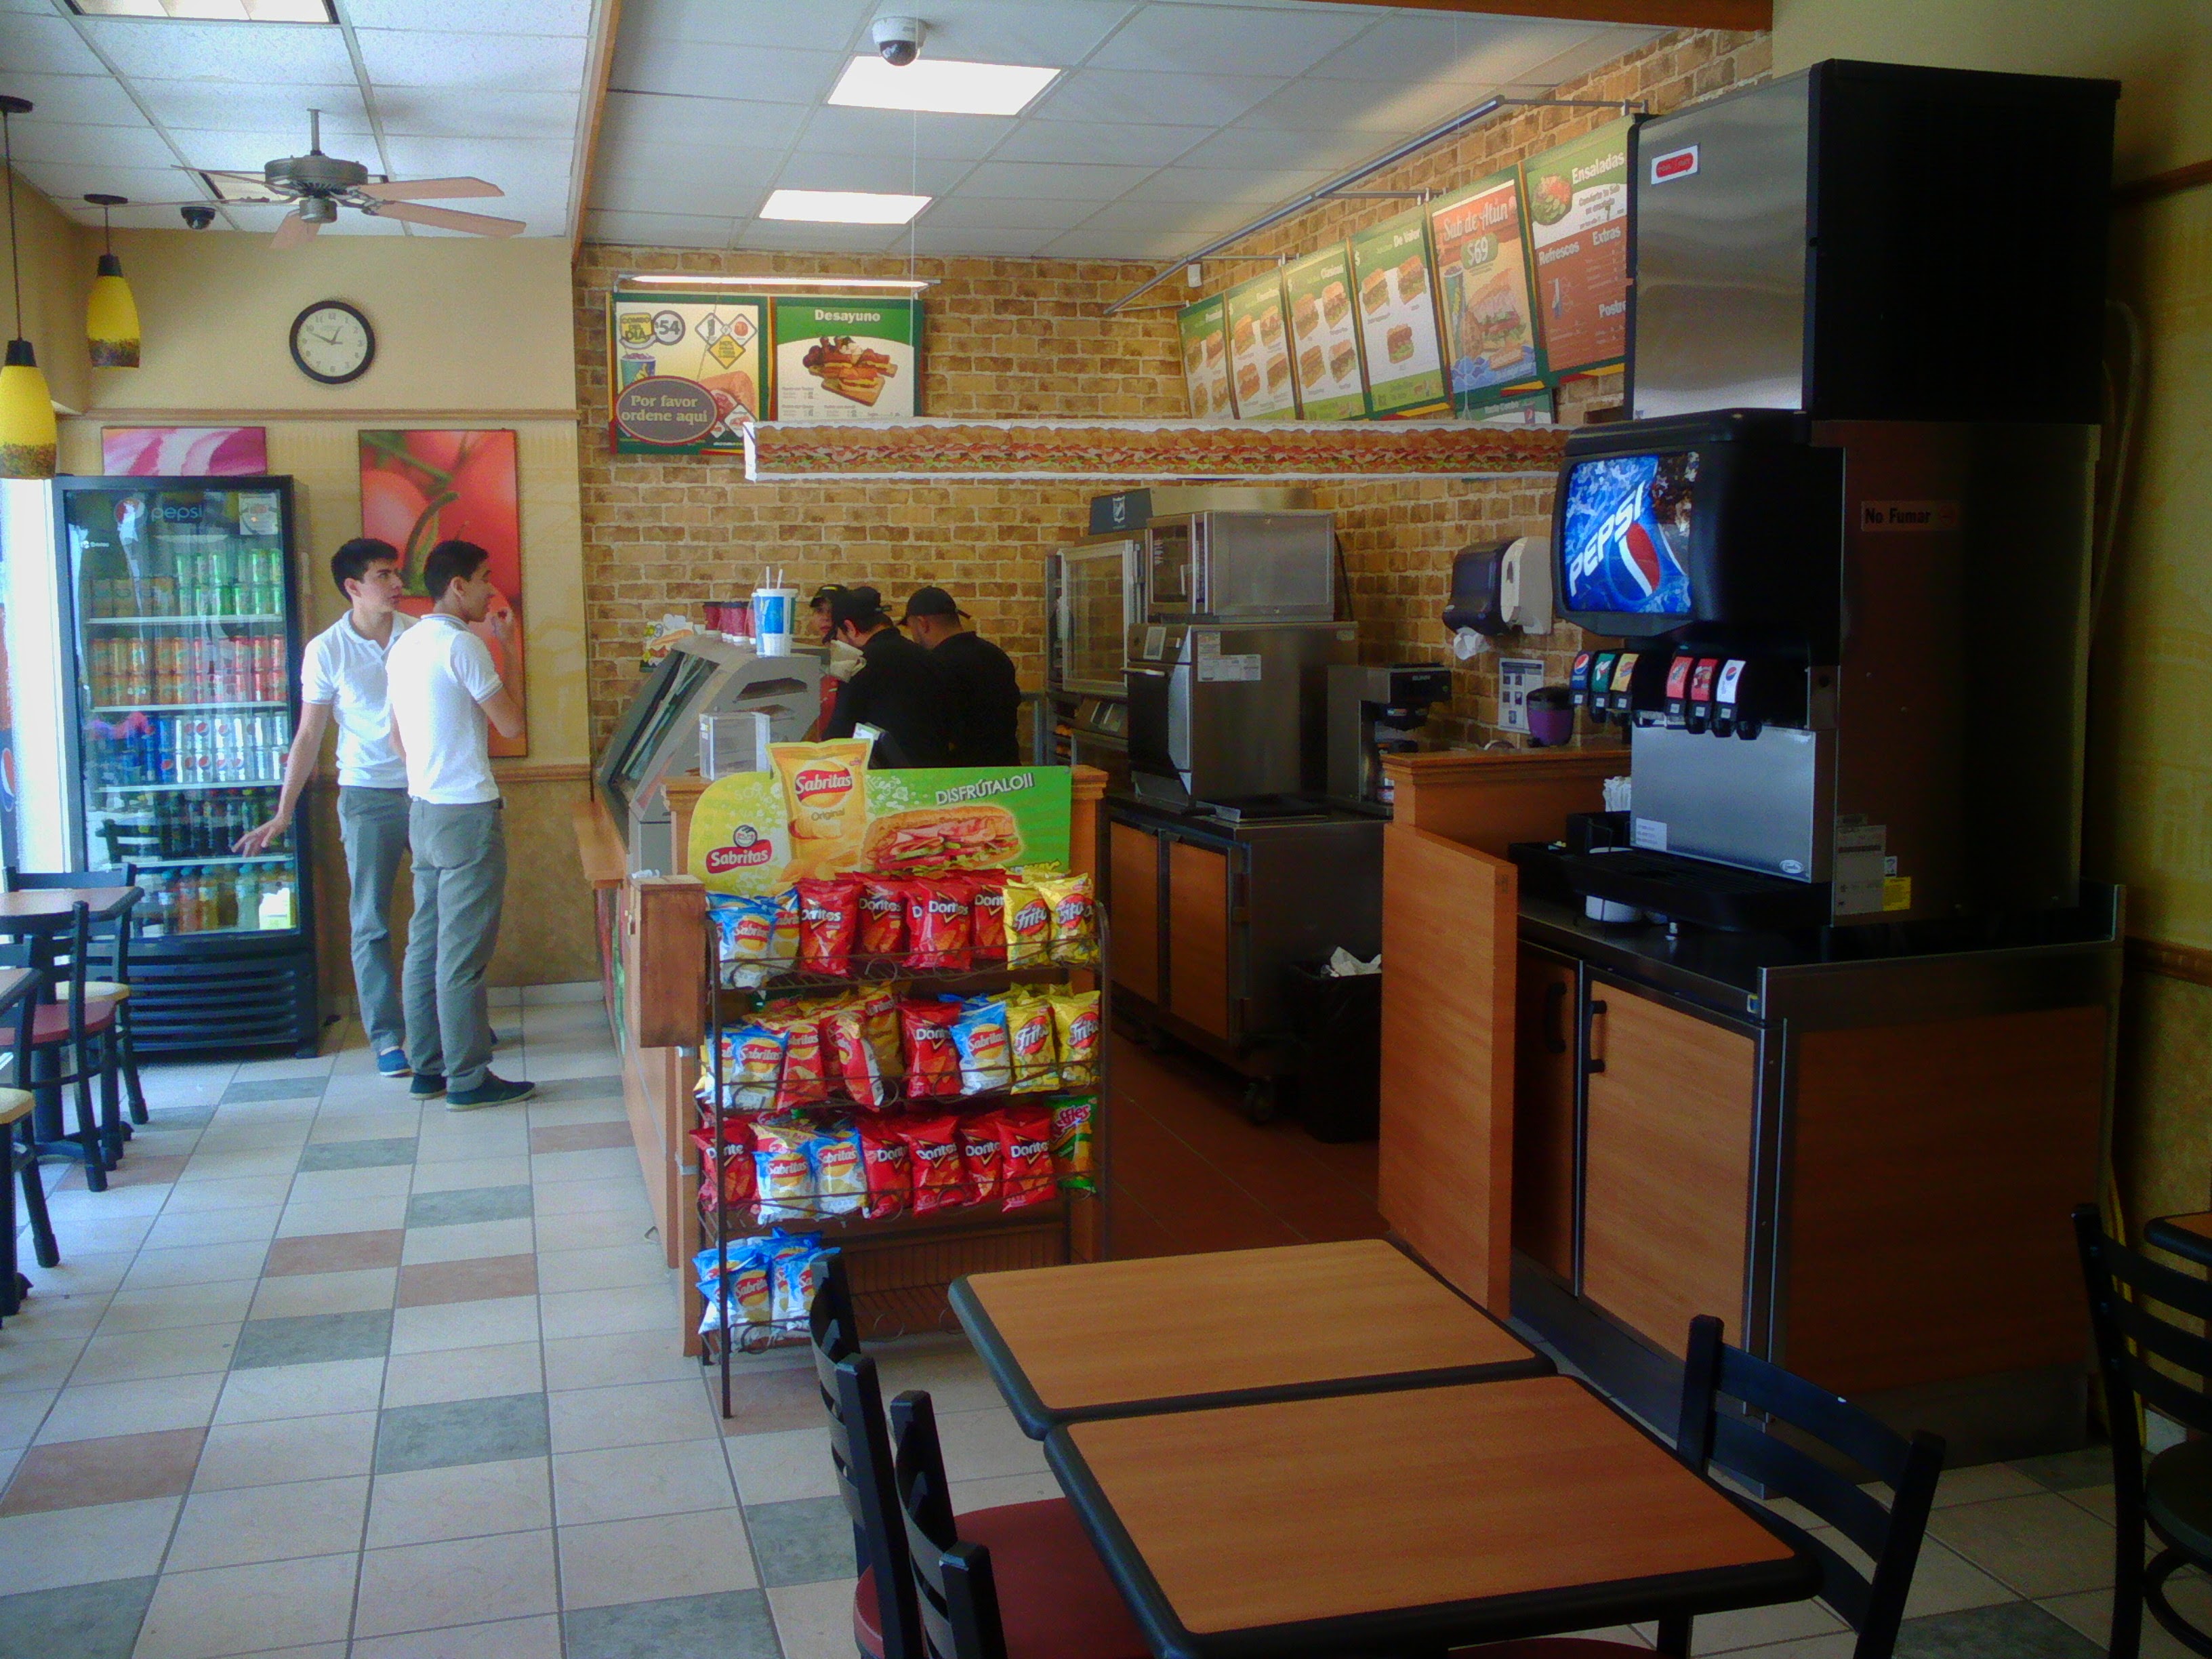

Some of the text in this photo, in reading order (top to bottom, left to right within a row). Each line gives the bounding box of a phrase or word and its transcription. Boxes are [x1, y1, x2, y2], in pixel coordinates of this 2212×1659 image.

[1572, 152, 1625, 184] Ensaladas
[1593, 226, 1621, 245] Extras
[1539, 241, 1580, 266] Refrescos
[815, 309, 880, 324] Desayuno
[1599, 300, 1626, 318] Postre
[631, 395, 698, 407] Por favor
[621, 409, 672, 422] ordene
[151, 506, 203, 520] pepsi
[1865, 508, 1931, 524] No Fumar
[1569, 479, 1646, 597] PEPSI
[795, 774, 853, 794] Sabritas
[811, 808, 846, 821] Original
[712, 848, 769, 866] Sabritas
[1012, 907, 1047, 931] Frito
[819, 1147, 857, 1164] Sabritas
[766, 1160, 808, 1174] Sabritas
